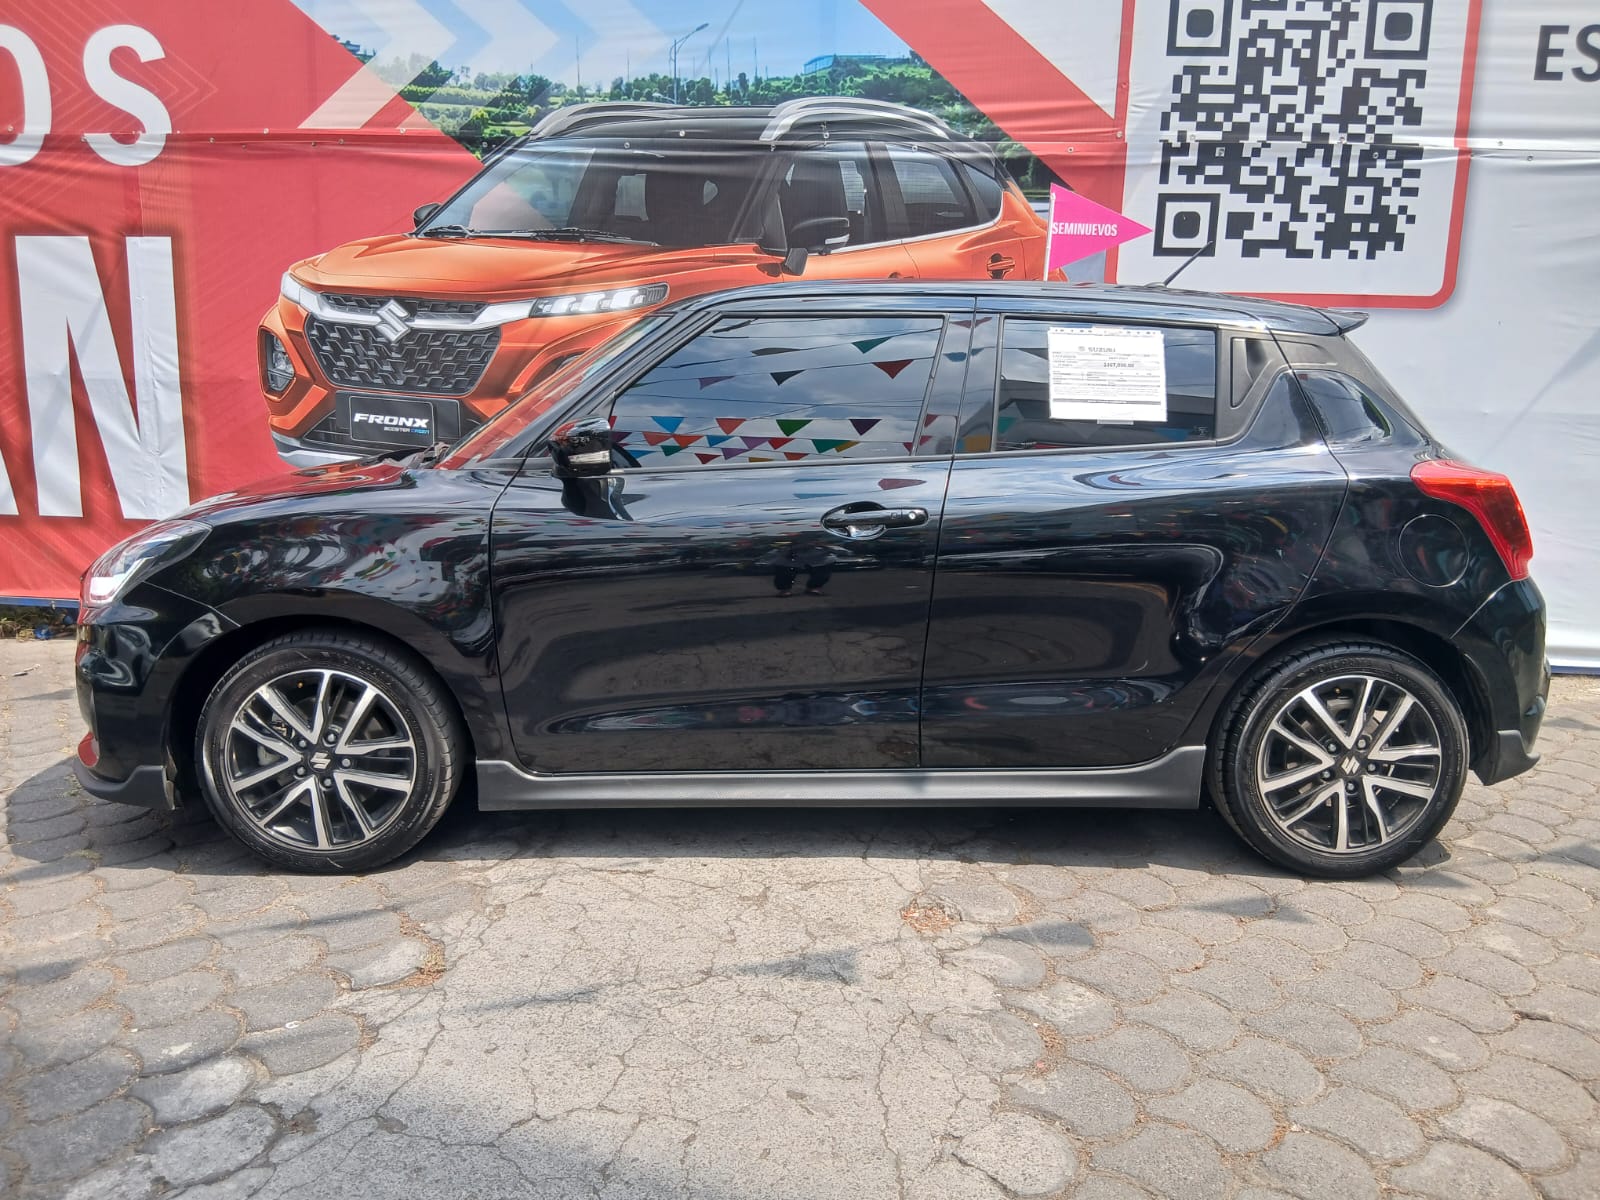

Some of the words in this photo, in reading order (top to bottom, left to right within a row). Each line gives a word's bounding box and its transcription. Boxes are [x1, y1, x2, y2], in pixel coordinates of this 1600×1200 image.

[1534, 24, 1600, 82] ES
[1052, 222, 1118, 236] SEMINUEVOS
[0, 235, 190, 520] N
[353, 412, 430, 428] FRONX
